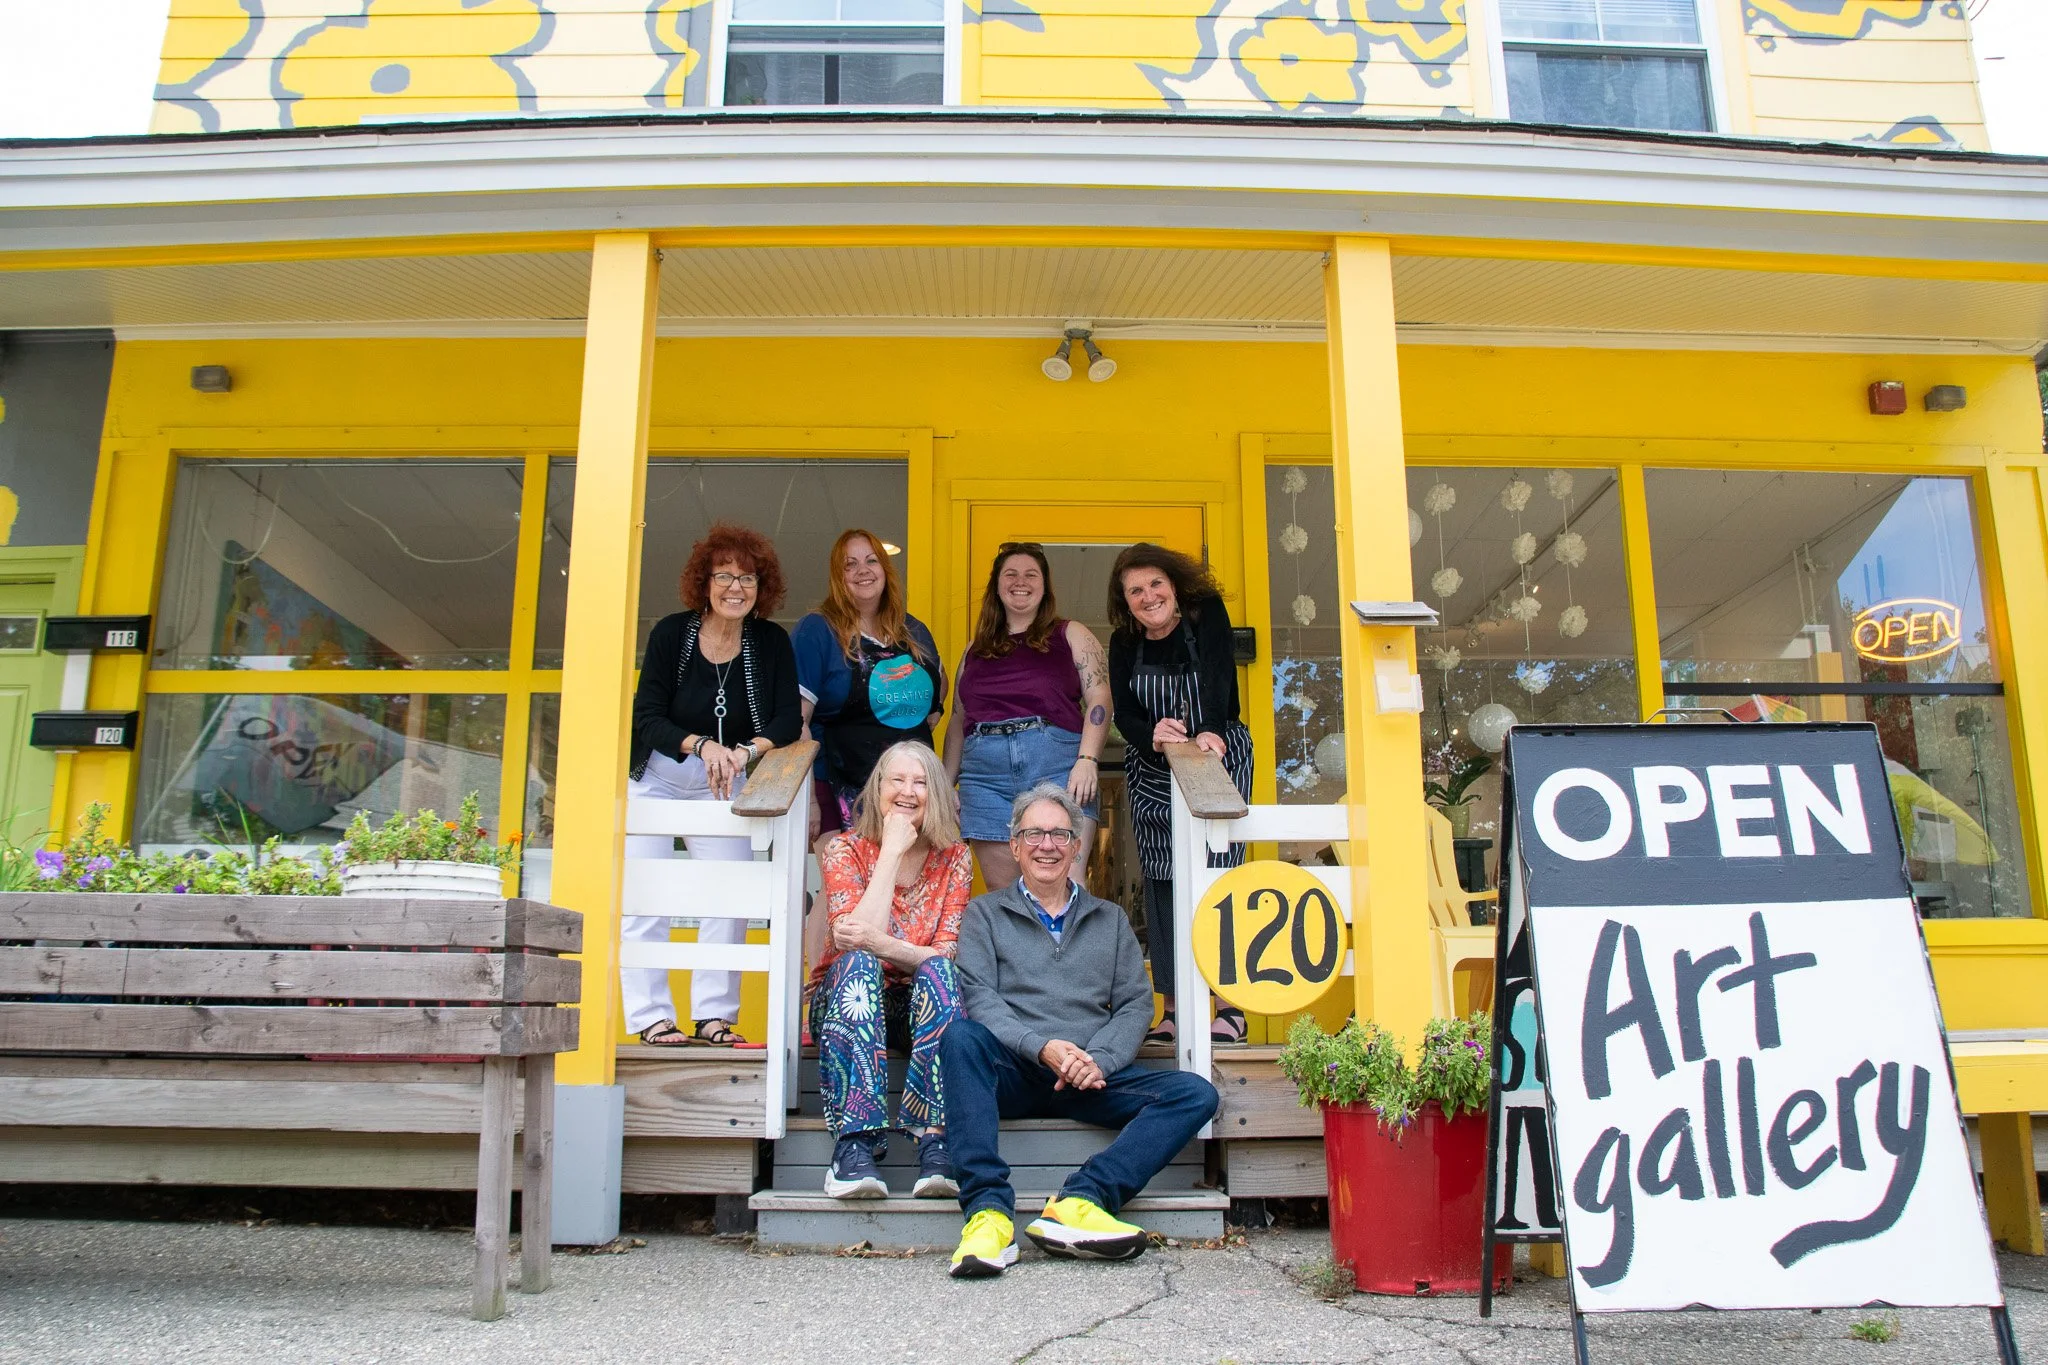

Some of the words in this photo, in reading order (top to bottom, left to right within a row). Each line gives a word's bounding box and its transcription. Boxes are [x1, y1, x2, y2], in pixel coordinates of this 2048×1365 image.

[111, 632, 134, 646] 118
[1854, 609, 1961, 652] OPEN
[876, 689, 930, 704] CREATIVE
[100, 729, 121, 743] 120
[1532, 762, 1874, 862] OPEN
[1212, 887, 1339, 986] 120
[1580, 910, 1818, 1100] Art
[1572, 1056, 1931, 1289] gallery
